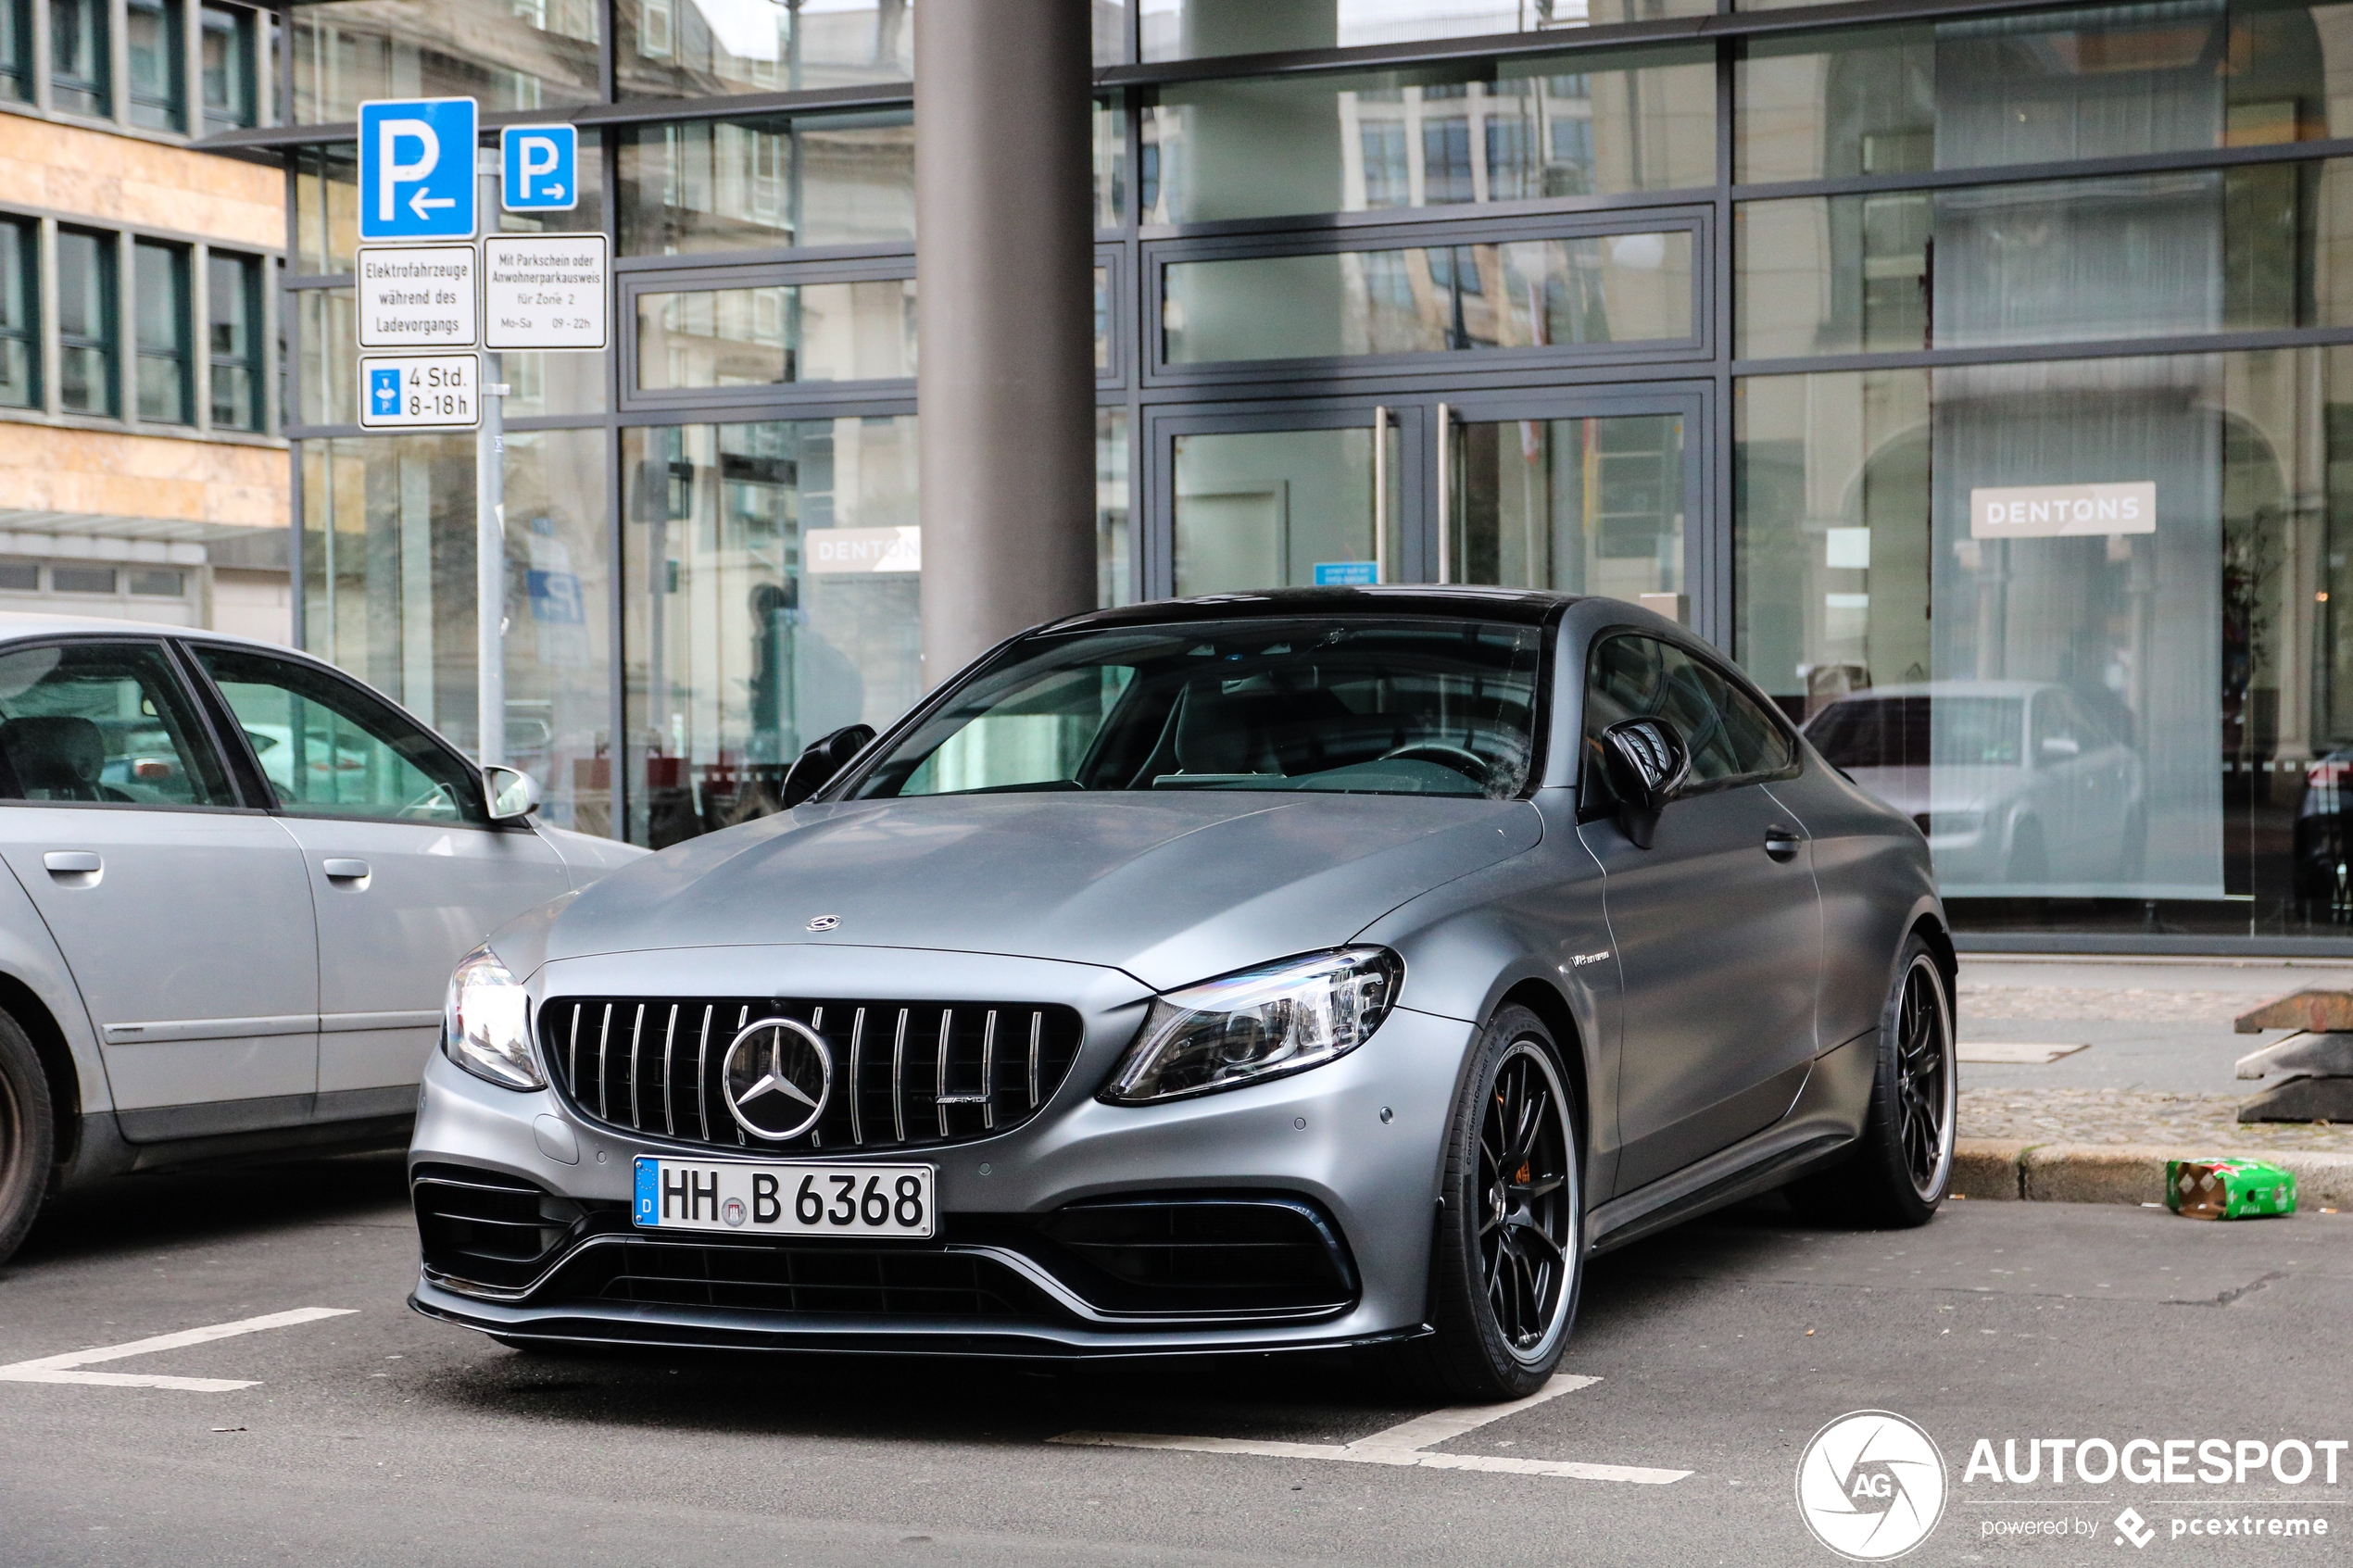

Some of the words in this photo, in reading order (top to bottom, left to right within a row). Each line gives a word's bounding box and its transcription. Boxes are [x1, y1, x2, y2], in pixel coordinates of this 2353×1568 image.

[379, 119, 439, 221] P
[520, 137, 559, 198] P
[499, 254, 514, 266] Mit
[517, 254, 569, 266] Parkschein
[573, 254, 594, 266] oder
[366, 263, 468, 280] Elektrofahrzeuge
[493, 270, 600, 286] Anwohnerparkausweis
[379, 290, 430, 305] während
[436, 289, 456, 304] des
[518, 294, 533, 304] für
[536, 294, 562, 304] Zone
[569, 294, 574, 304] 2
[376, 317, 459, 334] Ladevorgangs
[501, 319, 532, 328] Mo-Sa
[573, 319, 590, 329] 22h
[409, 368, 420, 387] 4
[429, 367, 467, 387] Std.
[1986, 496, 2140, 525] DENTONS
[643, 1199, 651, 1212] D
[662, 1169, 718, 1221] HH
[752, 1173, 781, 1223] B
[796, 1174, 923, 1227] 6368
